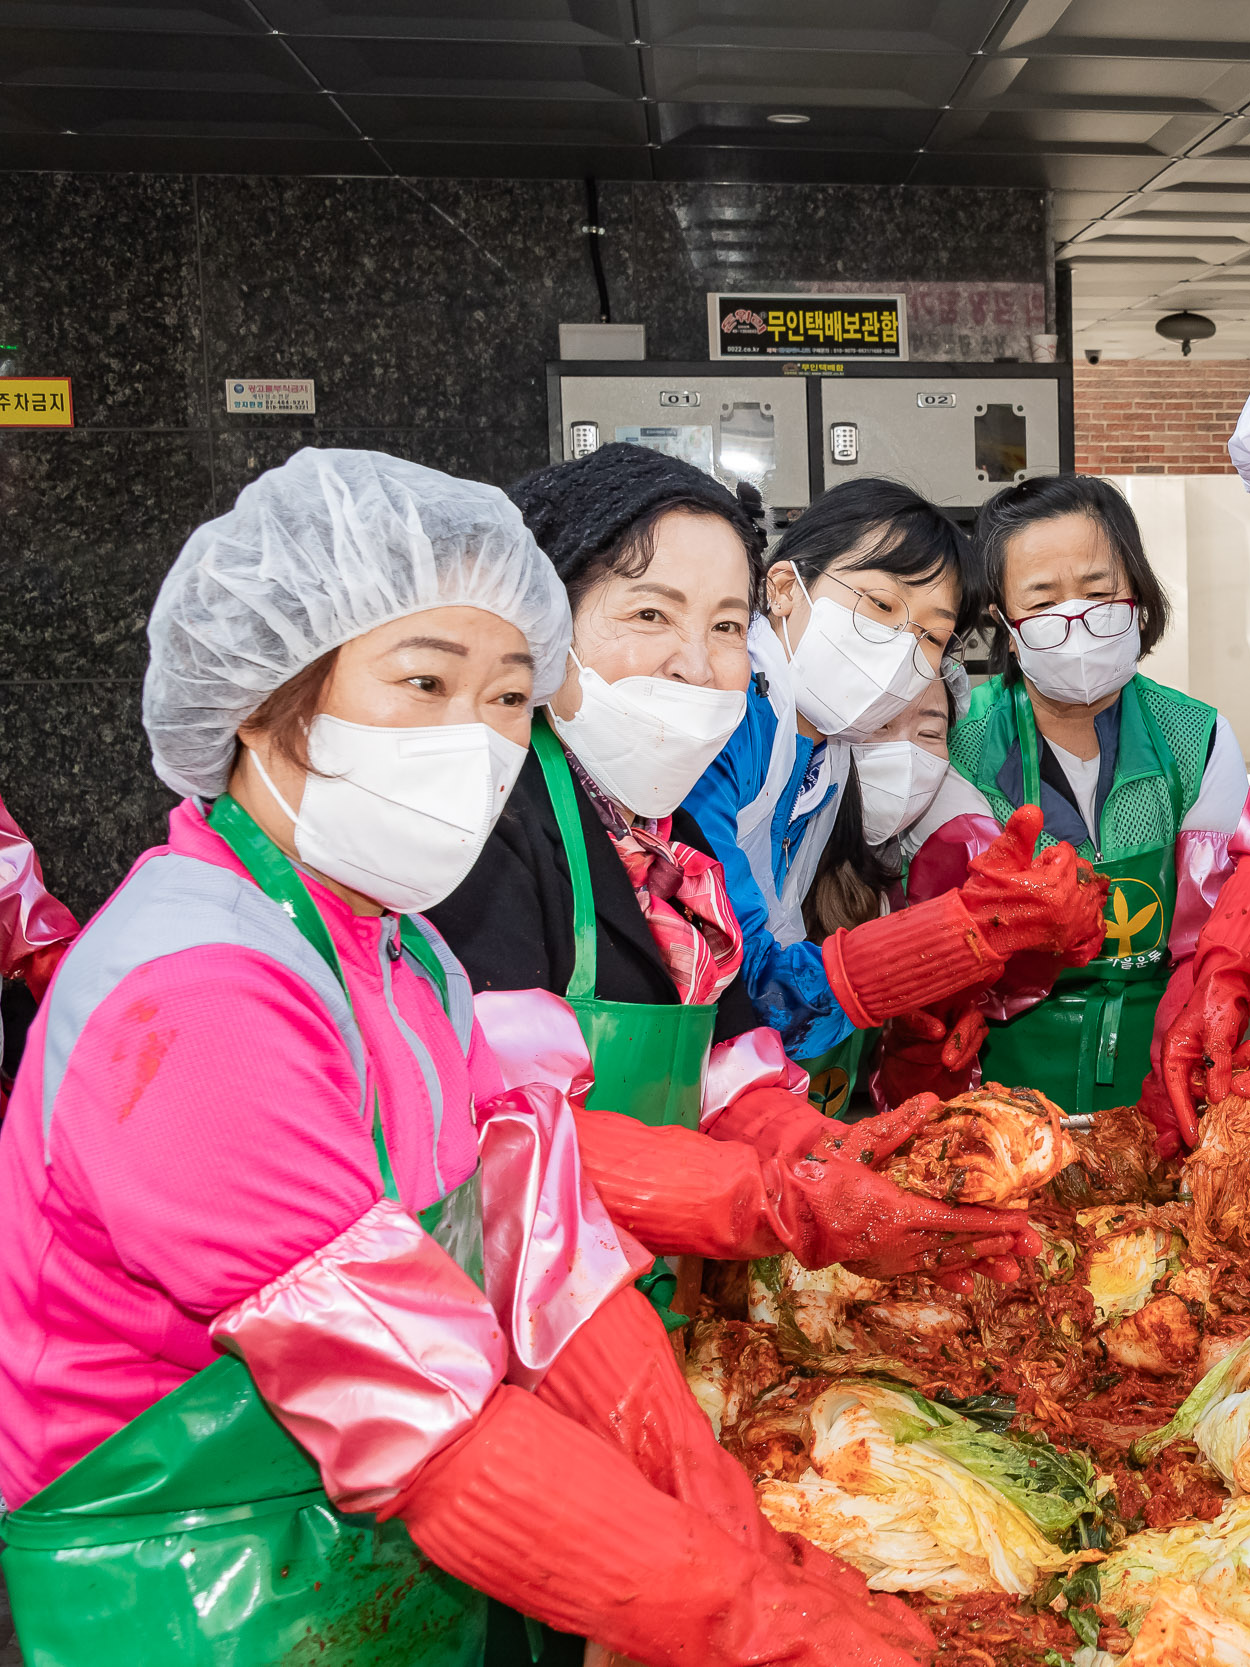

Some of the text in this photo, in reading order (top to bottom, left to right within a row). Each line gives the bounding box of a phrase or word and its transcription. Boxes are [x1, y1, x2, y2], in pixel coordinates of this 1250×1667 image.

[767, 310, 898, 342] 무인택배보관함
[0, 392, 64, 412] 주차금지
[668, 395, 690, 404] 01
[925, 396, 948, 405] 02
